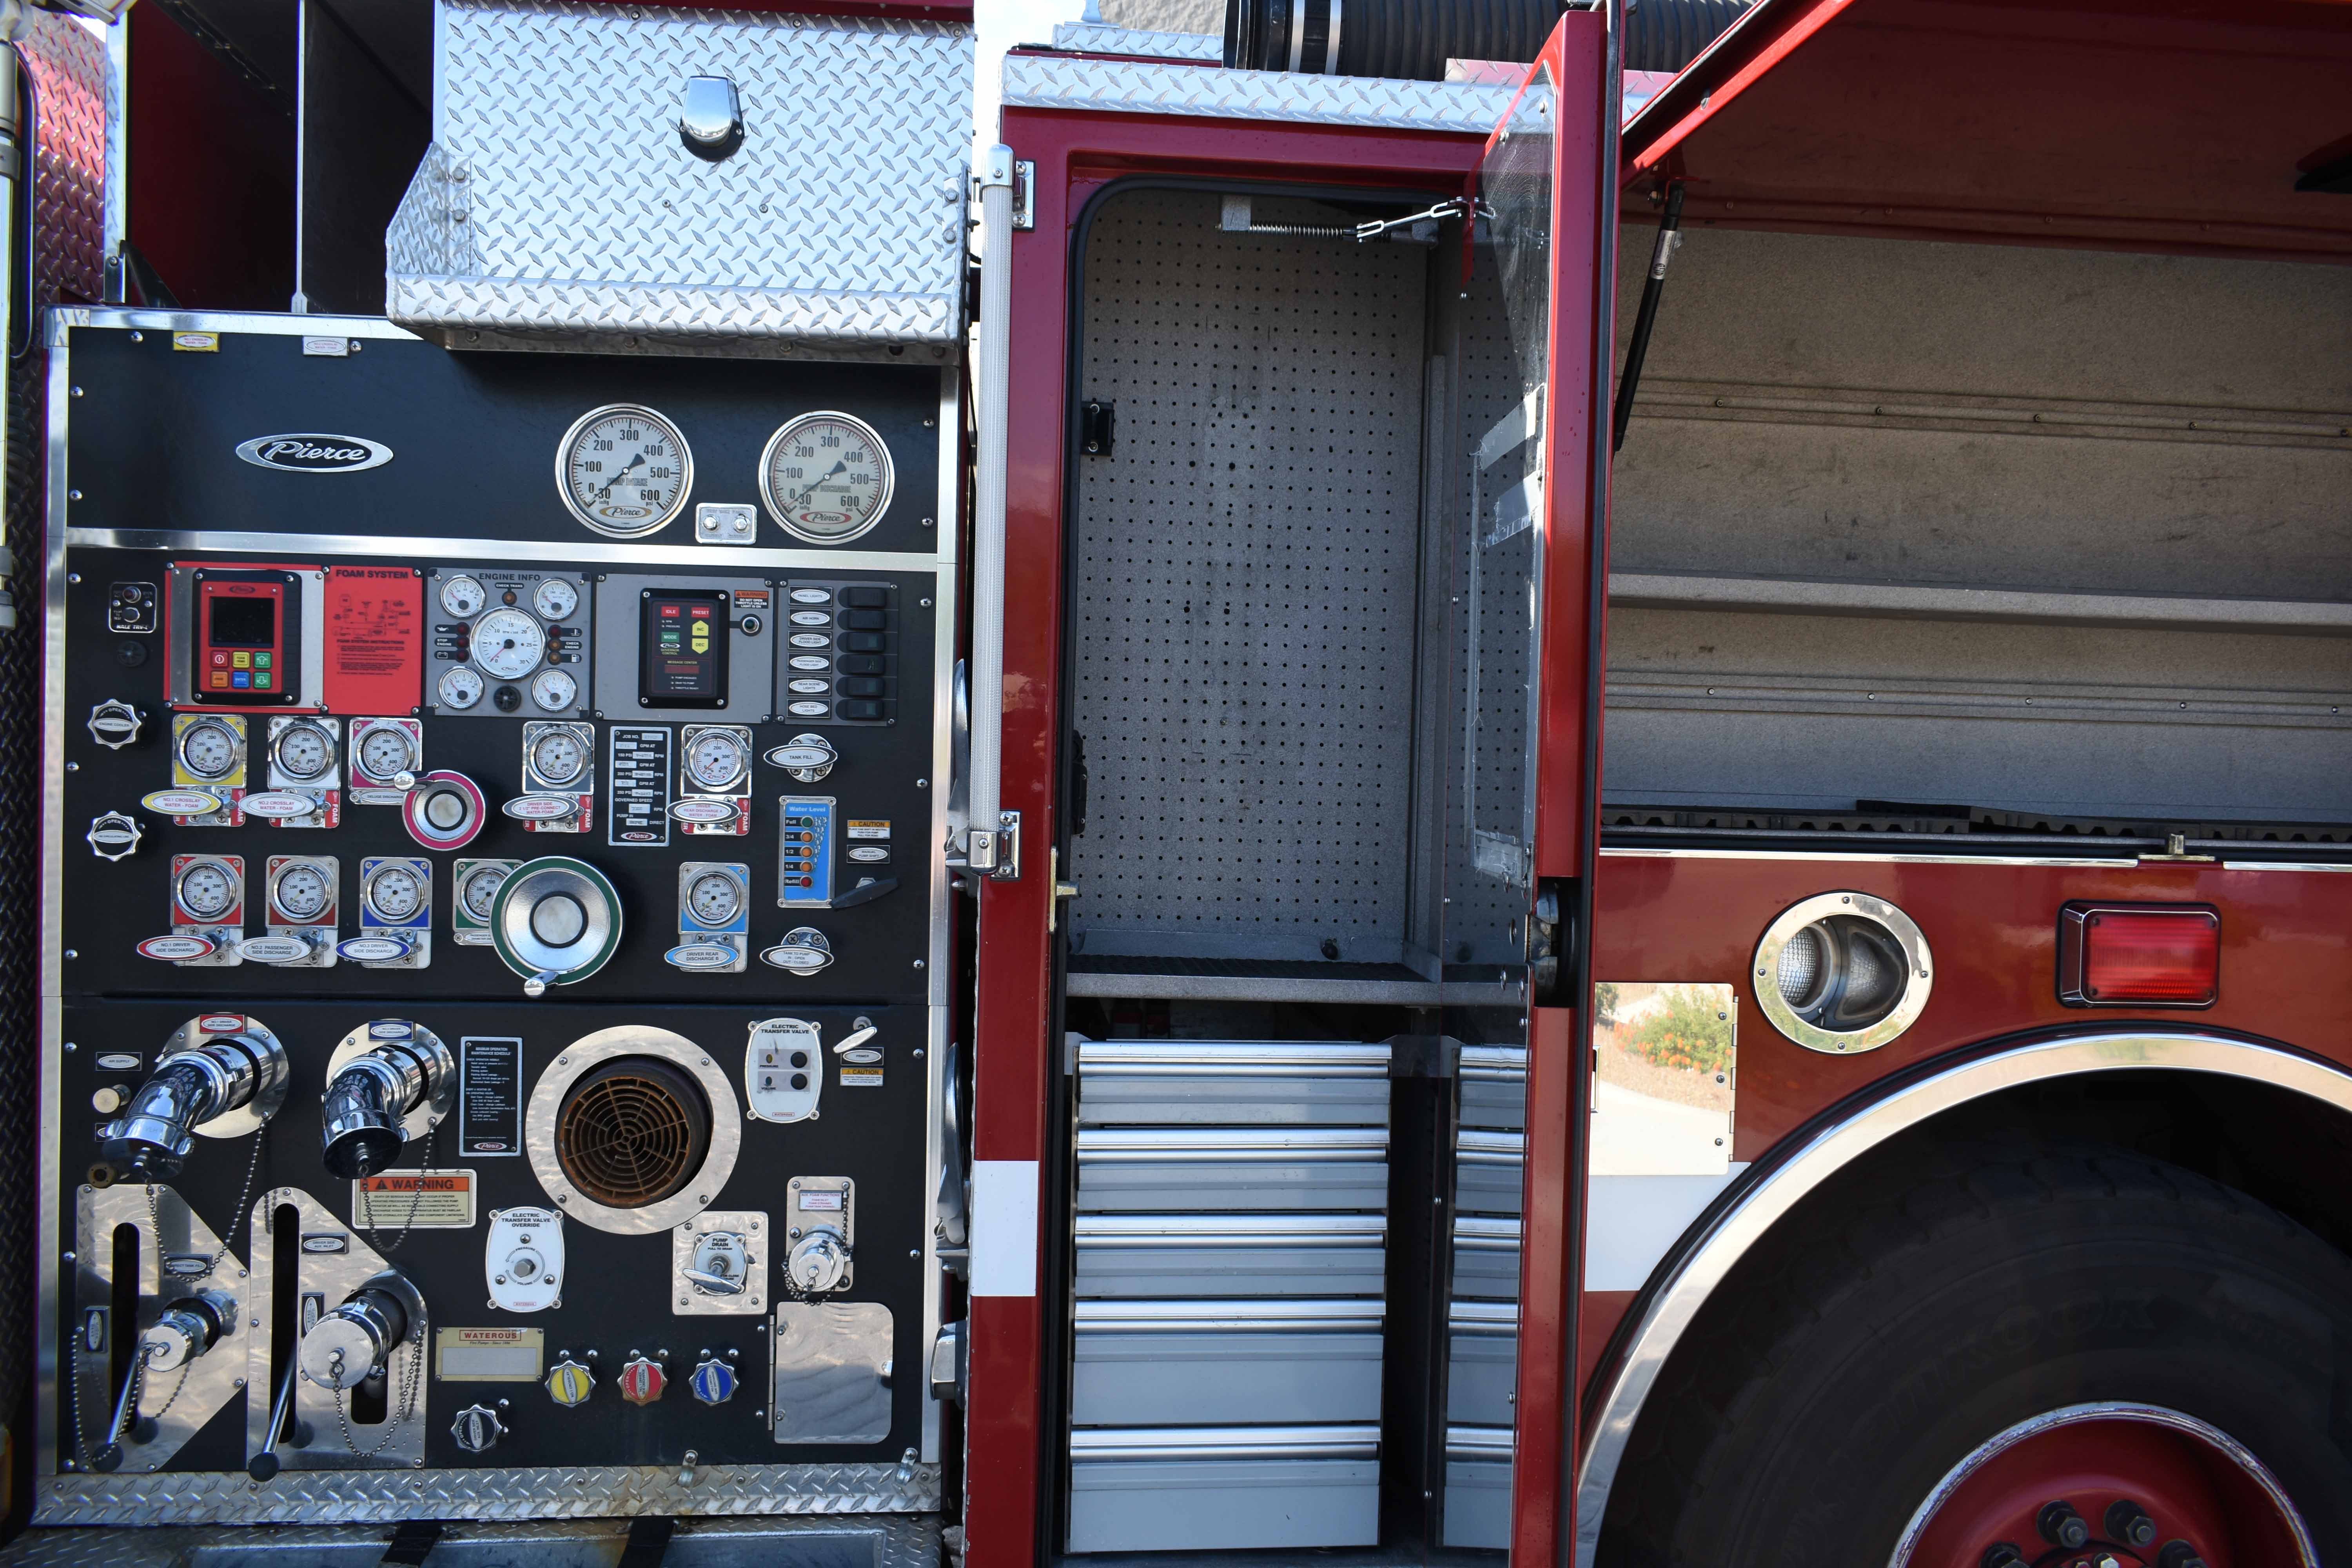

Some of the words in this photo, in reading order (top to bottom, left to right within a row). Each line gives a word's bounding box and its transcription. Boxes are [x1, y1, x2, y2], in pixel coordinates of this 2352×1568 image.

[619, 430, 639, 441] 300
[593, 440, 613, 451] 200
[820, 436, 840, 448] 300
[264, 441, 365, 460] Pierce
[644, 445, 663, 456] 400
[795, 446, 814, 457] 200
[844, 452, 863, 463] 400
[585, 461, 602, 472] 100
[650, 467, 669, 478] 500
[786, 468, 803, 478] 100
[850, 474, 869, 485] 500
[589, 483, 594, 493] 0
[789, 488, 795, 499] 0
[641, 490, 660, 501] 600
[840, 496, 859, 507] 600
[612, 506, 641, 516] Pierce
[812, 513, 840, 522] Pierce
[336, 569, 365, 578] FOAM
[367, 570, 408, 579] SYSTEM
